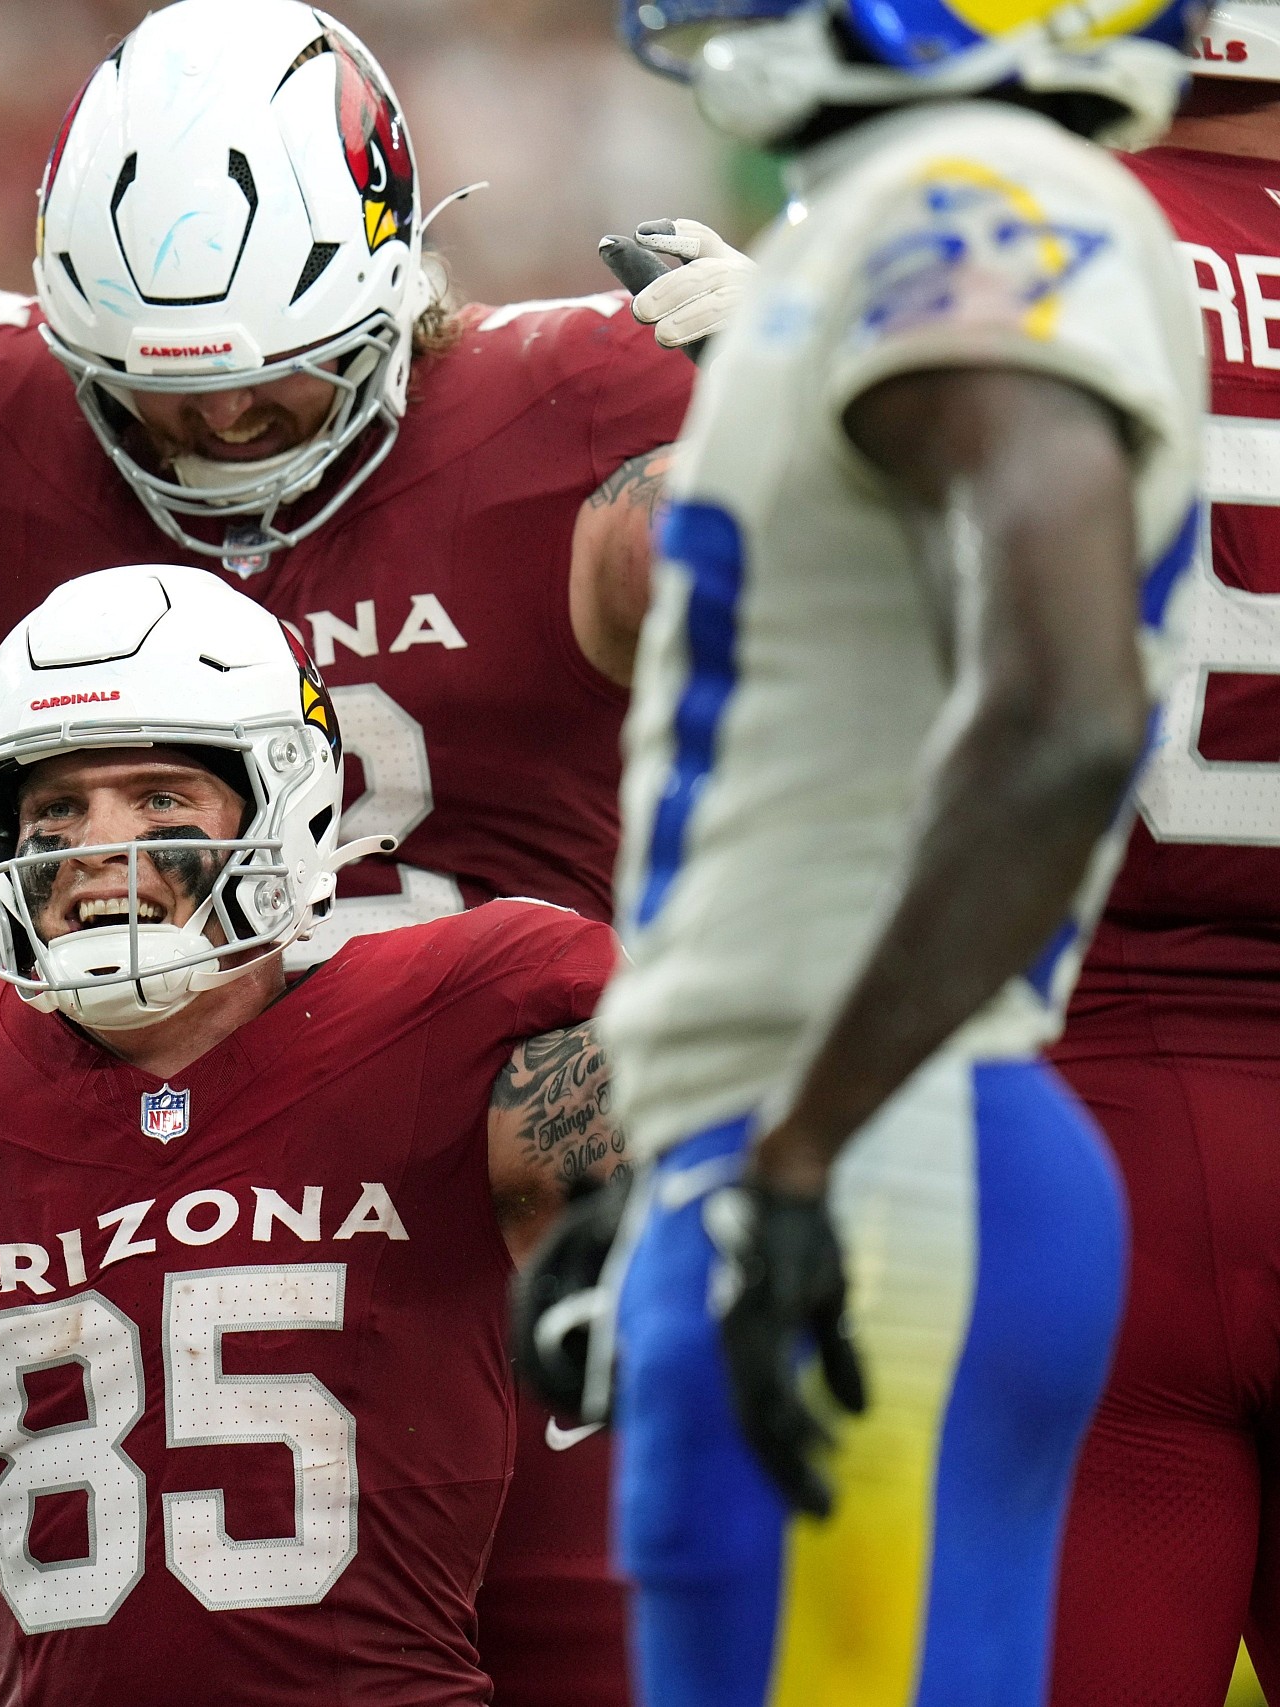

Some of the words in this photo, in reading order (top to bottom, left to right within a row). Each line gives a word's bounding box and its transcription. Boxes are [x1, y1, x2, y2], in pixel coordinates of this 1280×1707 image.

[139, 342, 233, 358] CARDINALS
[282, 593, 468, 667] NA
[30, 690, 121, 711] CARDINALS
[148, 1110, 182, 1133] NFL
[539, 1103, 596, 1152] Things
[563, 1132, 608, 1179] Who
